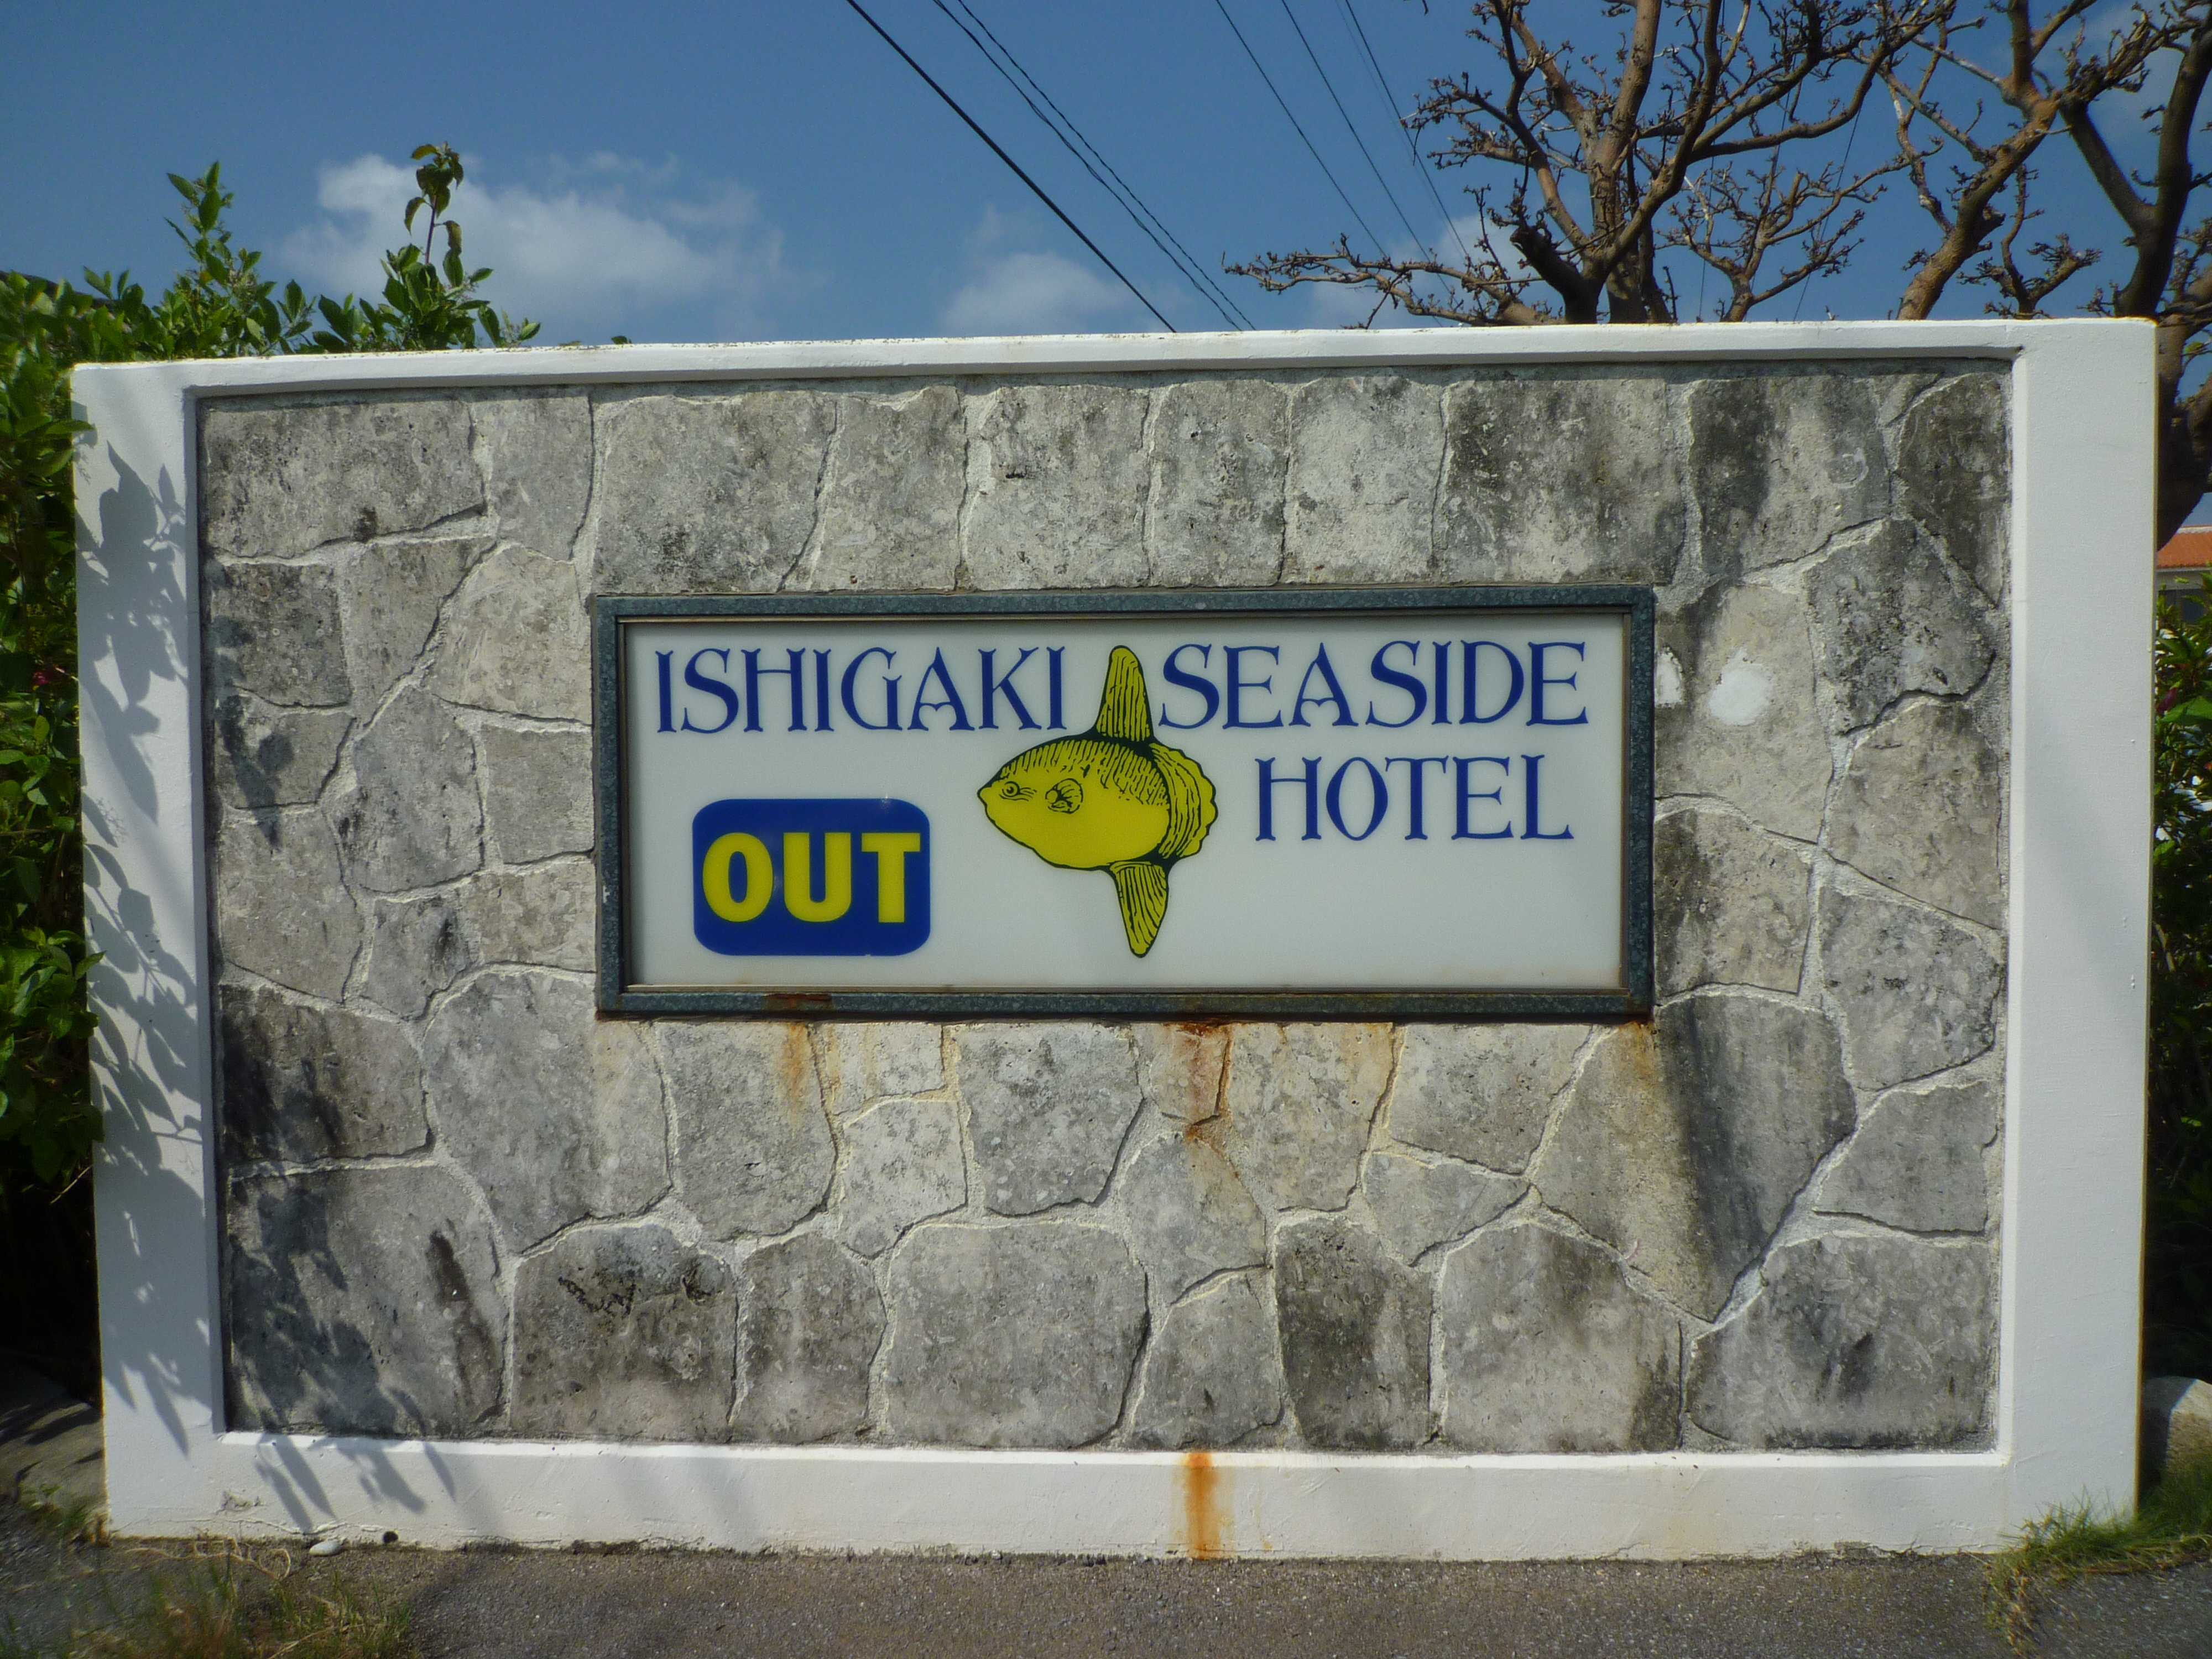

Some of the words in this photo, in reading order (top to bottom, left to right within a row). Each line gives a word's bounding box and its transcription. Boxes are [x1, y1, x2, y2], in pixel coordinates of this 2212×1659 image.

[654, 644, 1068, 734] ISHIGAKI
[1157, 639, 1589, 730] SEASIDE
[1254, 754, 1575, 842] HOTEL
[703, 833, 920, 922] OUT
